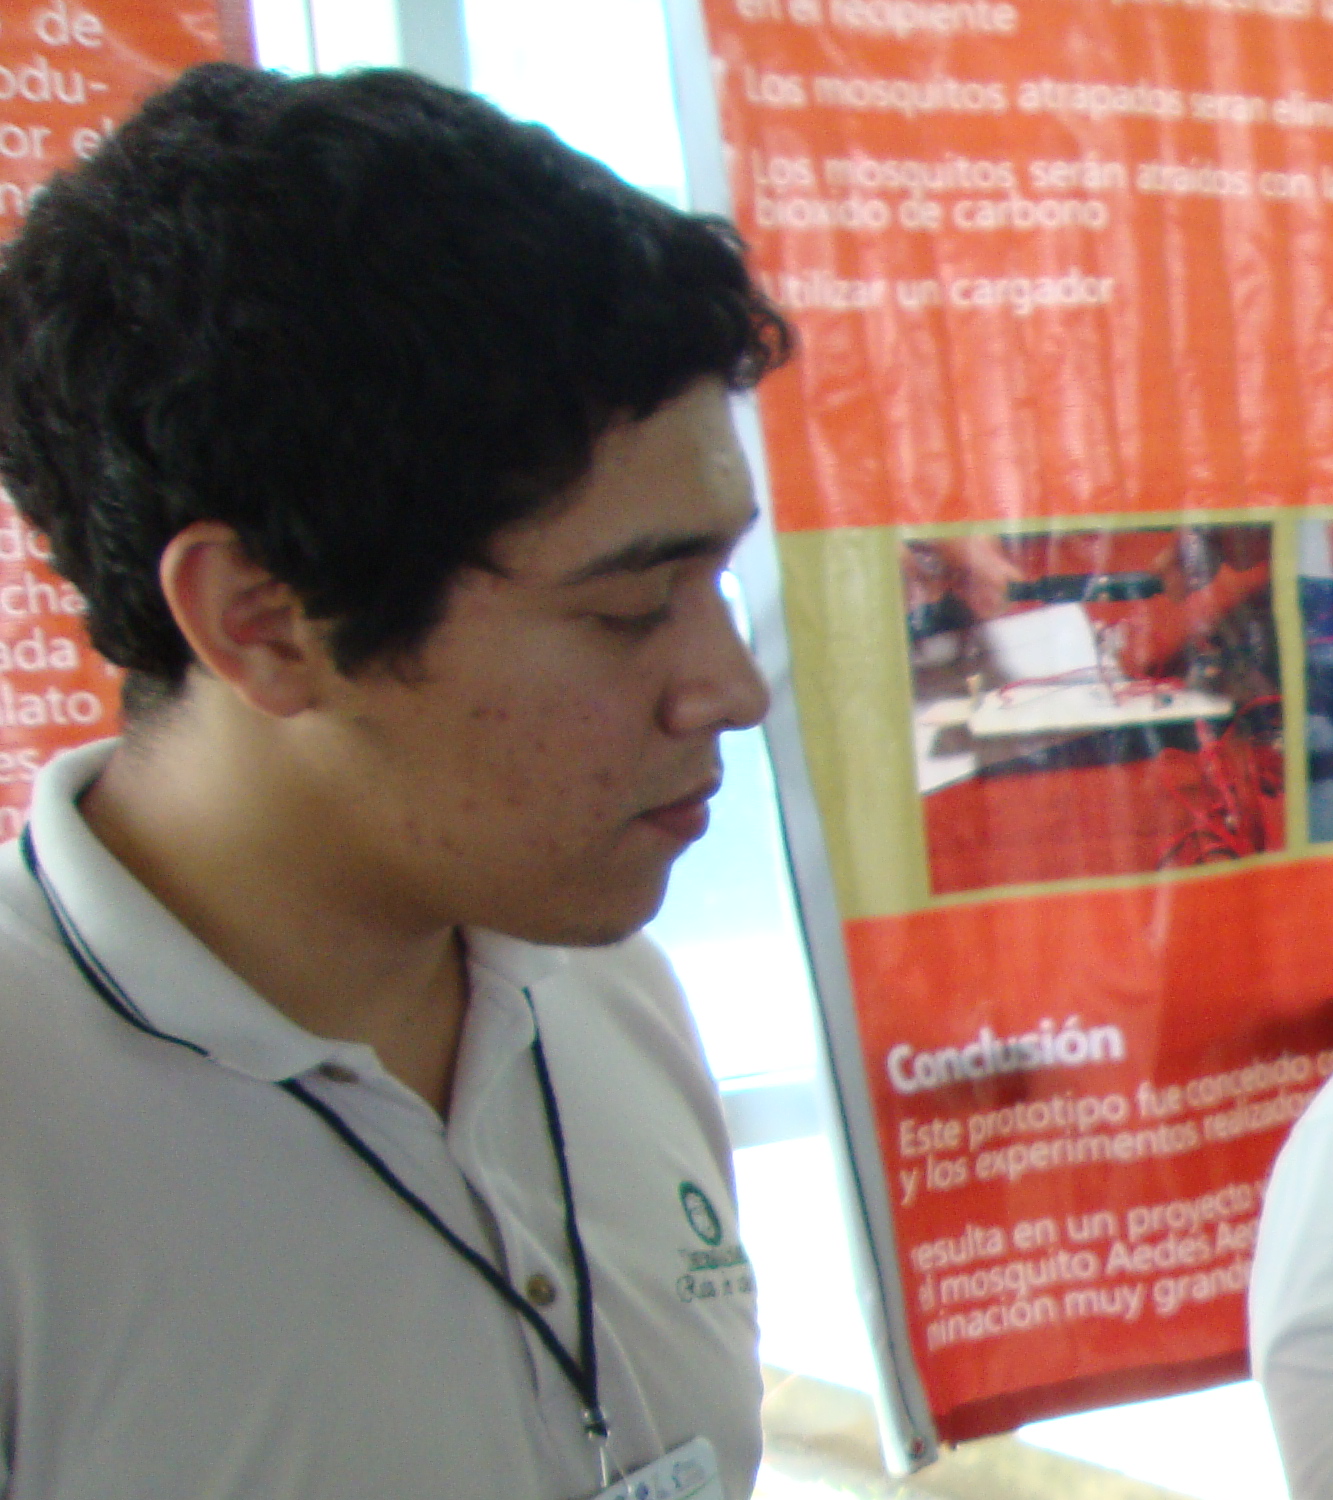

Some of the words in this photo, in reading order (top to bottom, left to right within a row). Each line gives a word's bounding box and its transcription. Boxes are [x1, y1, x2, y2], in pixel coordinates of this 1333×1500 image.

[34, 0, 103, 46] de
[814, 72, 1008, 119] mosquitos
[823, 151, 1015, 199] mosquitos
[951, 265, 1116, 318] cargador
[887, 1015, 1125, 1093] Conclusión
[900, 1118, 963, 1157] Este
[968, 1091, 1130, 1152] prototipo
[1137, 1080, 1182, 1117] fue
[901, 1166, 919, 1207] y
[927, 1153, 968, 1191] los
[976, 1120, 1198, 1181] experimentos
[1013, 1217, 1058, 1250] en
[1066, 1210, 1118, 1243] un
[940, 1248, 1099, 1298] mosquito
[1105, 1233, 1211, 1277] Aedes
[1064, 1281, 1143, 1321] muy
